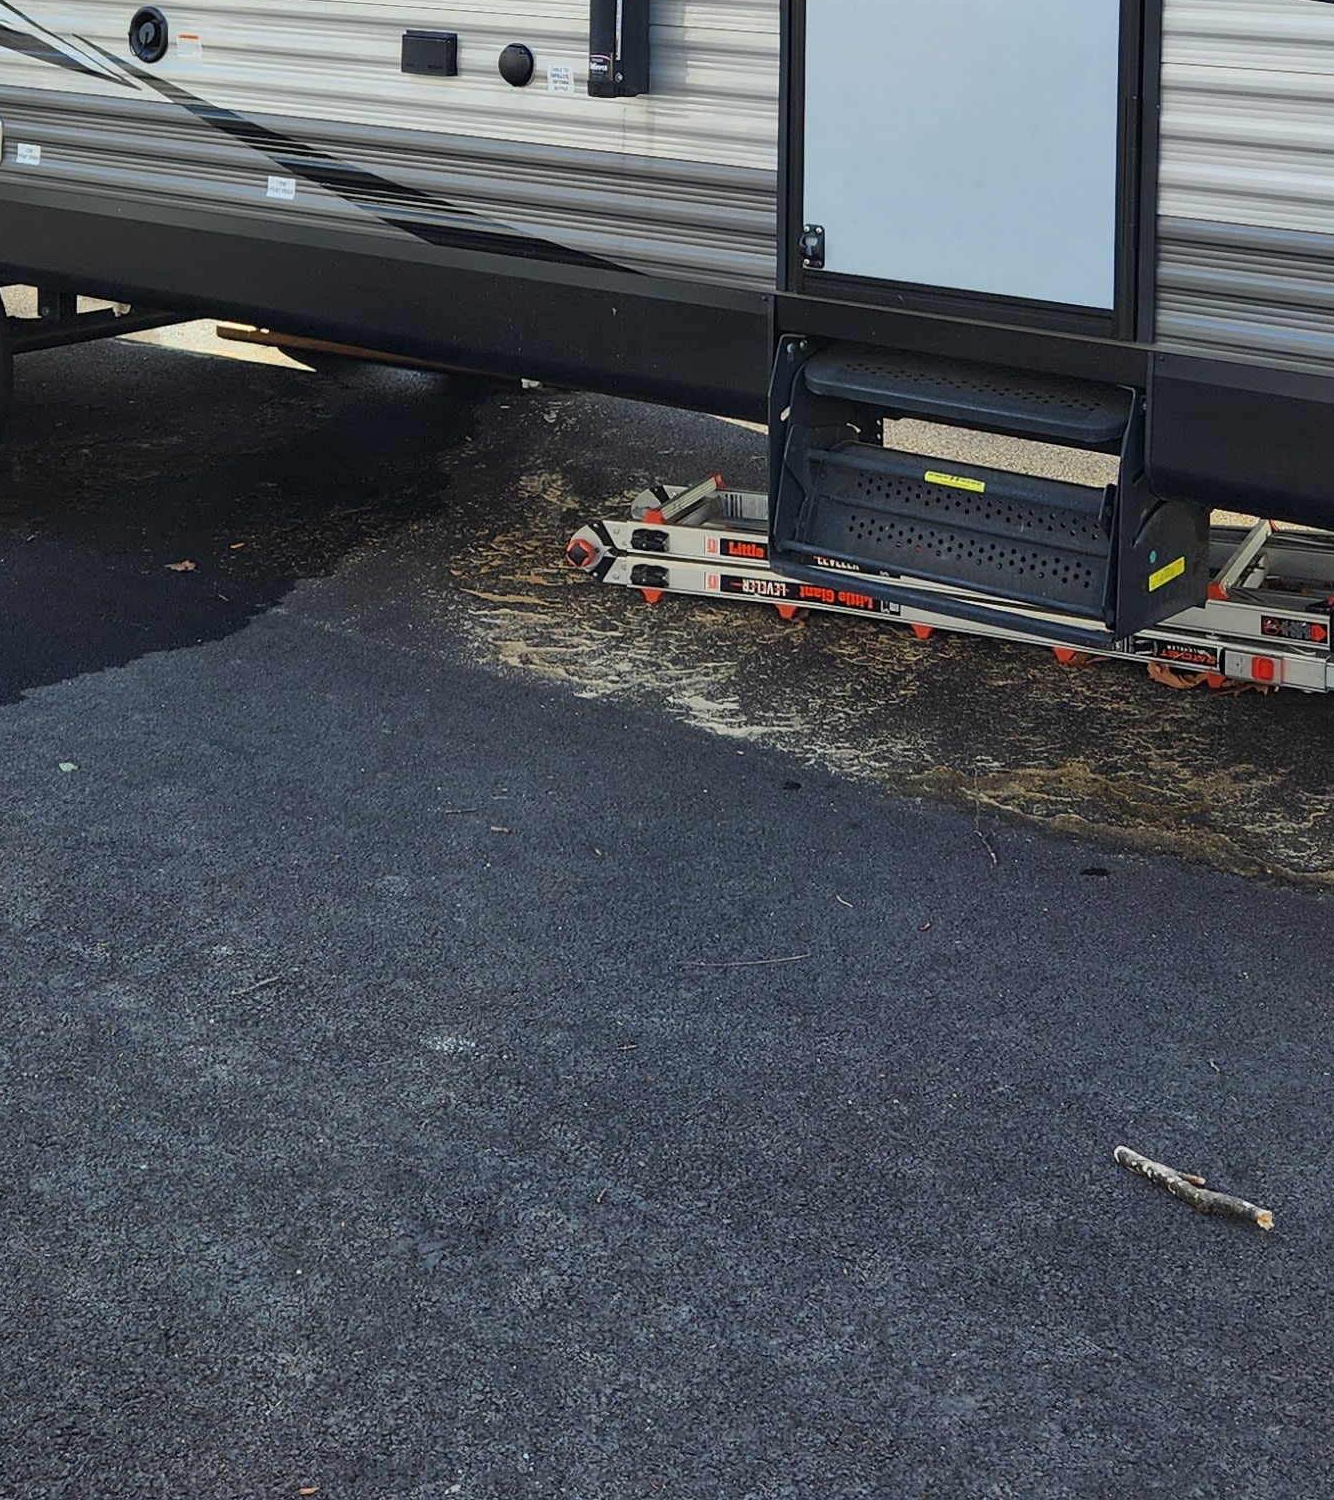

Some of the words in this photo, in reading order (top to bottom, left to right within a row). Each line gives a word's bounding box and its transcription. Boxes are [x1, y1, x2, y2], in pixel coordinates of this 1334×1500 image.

[729, 541, 764, 558] Little
[742, 579, 787, 597] LEVELER
[799, 585, 835, 603] Giant
[838, 590, 874, 609] Little
